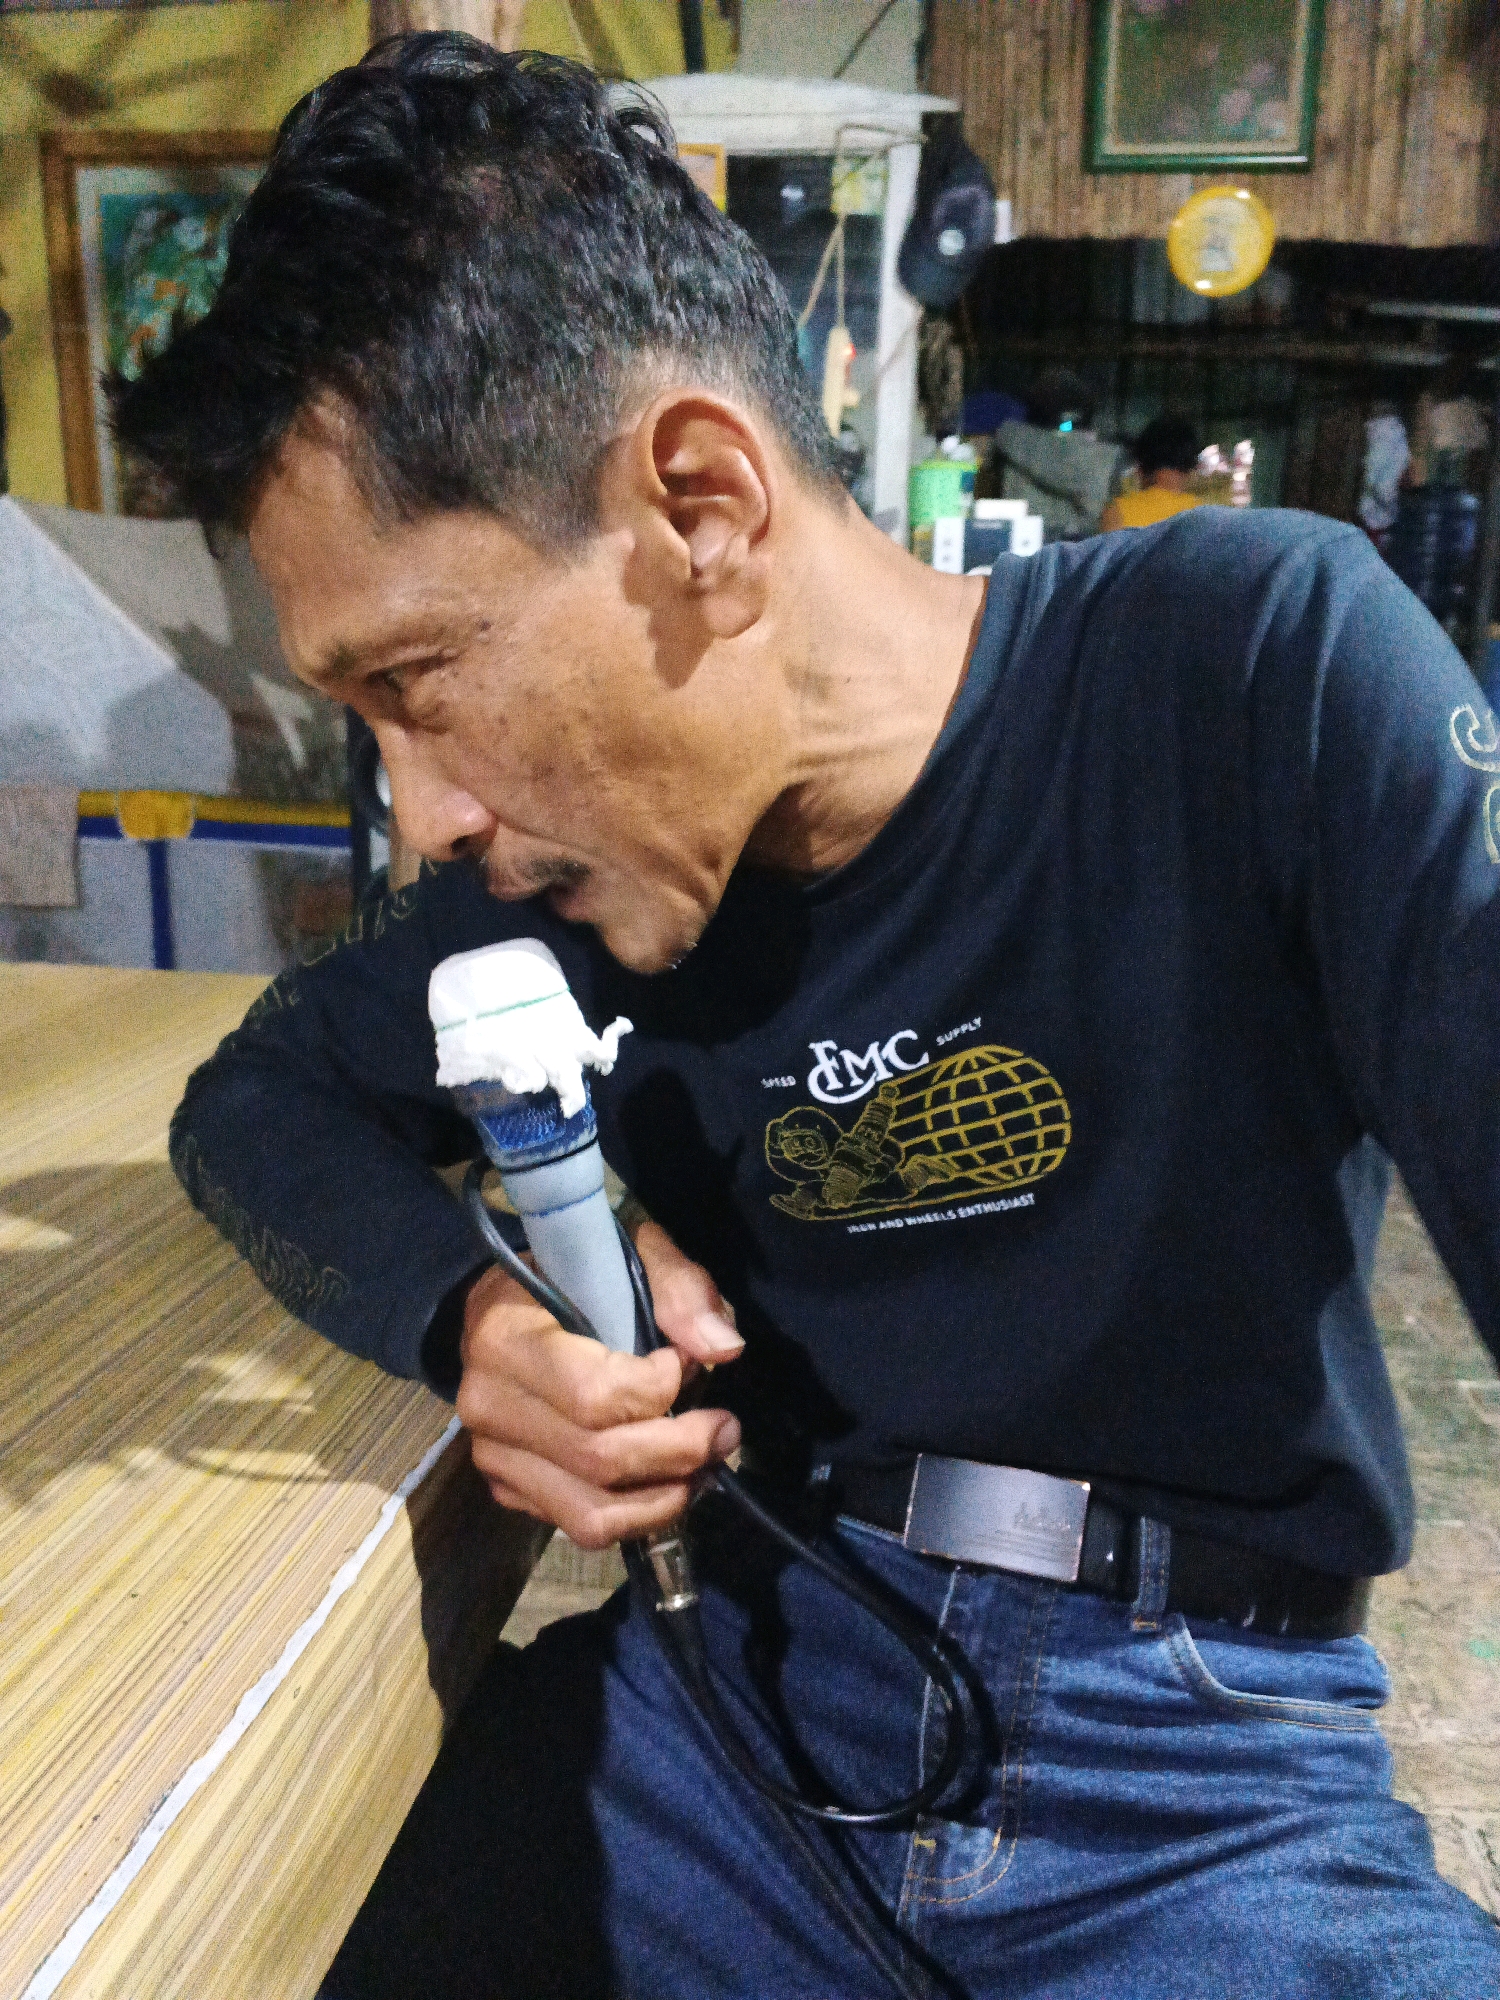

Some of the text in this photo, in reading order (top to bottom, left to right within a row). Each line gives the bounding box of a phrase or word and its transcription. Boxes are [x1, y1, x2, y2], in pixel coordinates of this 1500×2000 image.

[807, 1029, 930, 1104] FMC
[935, 1016, 982, 1046] SUPPLY
[878, 1218, 904, 1230] AND
[904, 1209, 957, 1226] WHEELS
[957, 1192, 1036, 1219] ENTHUSIAST
